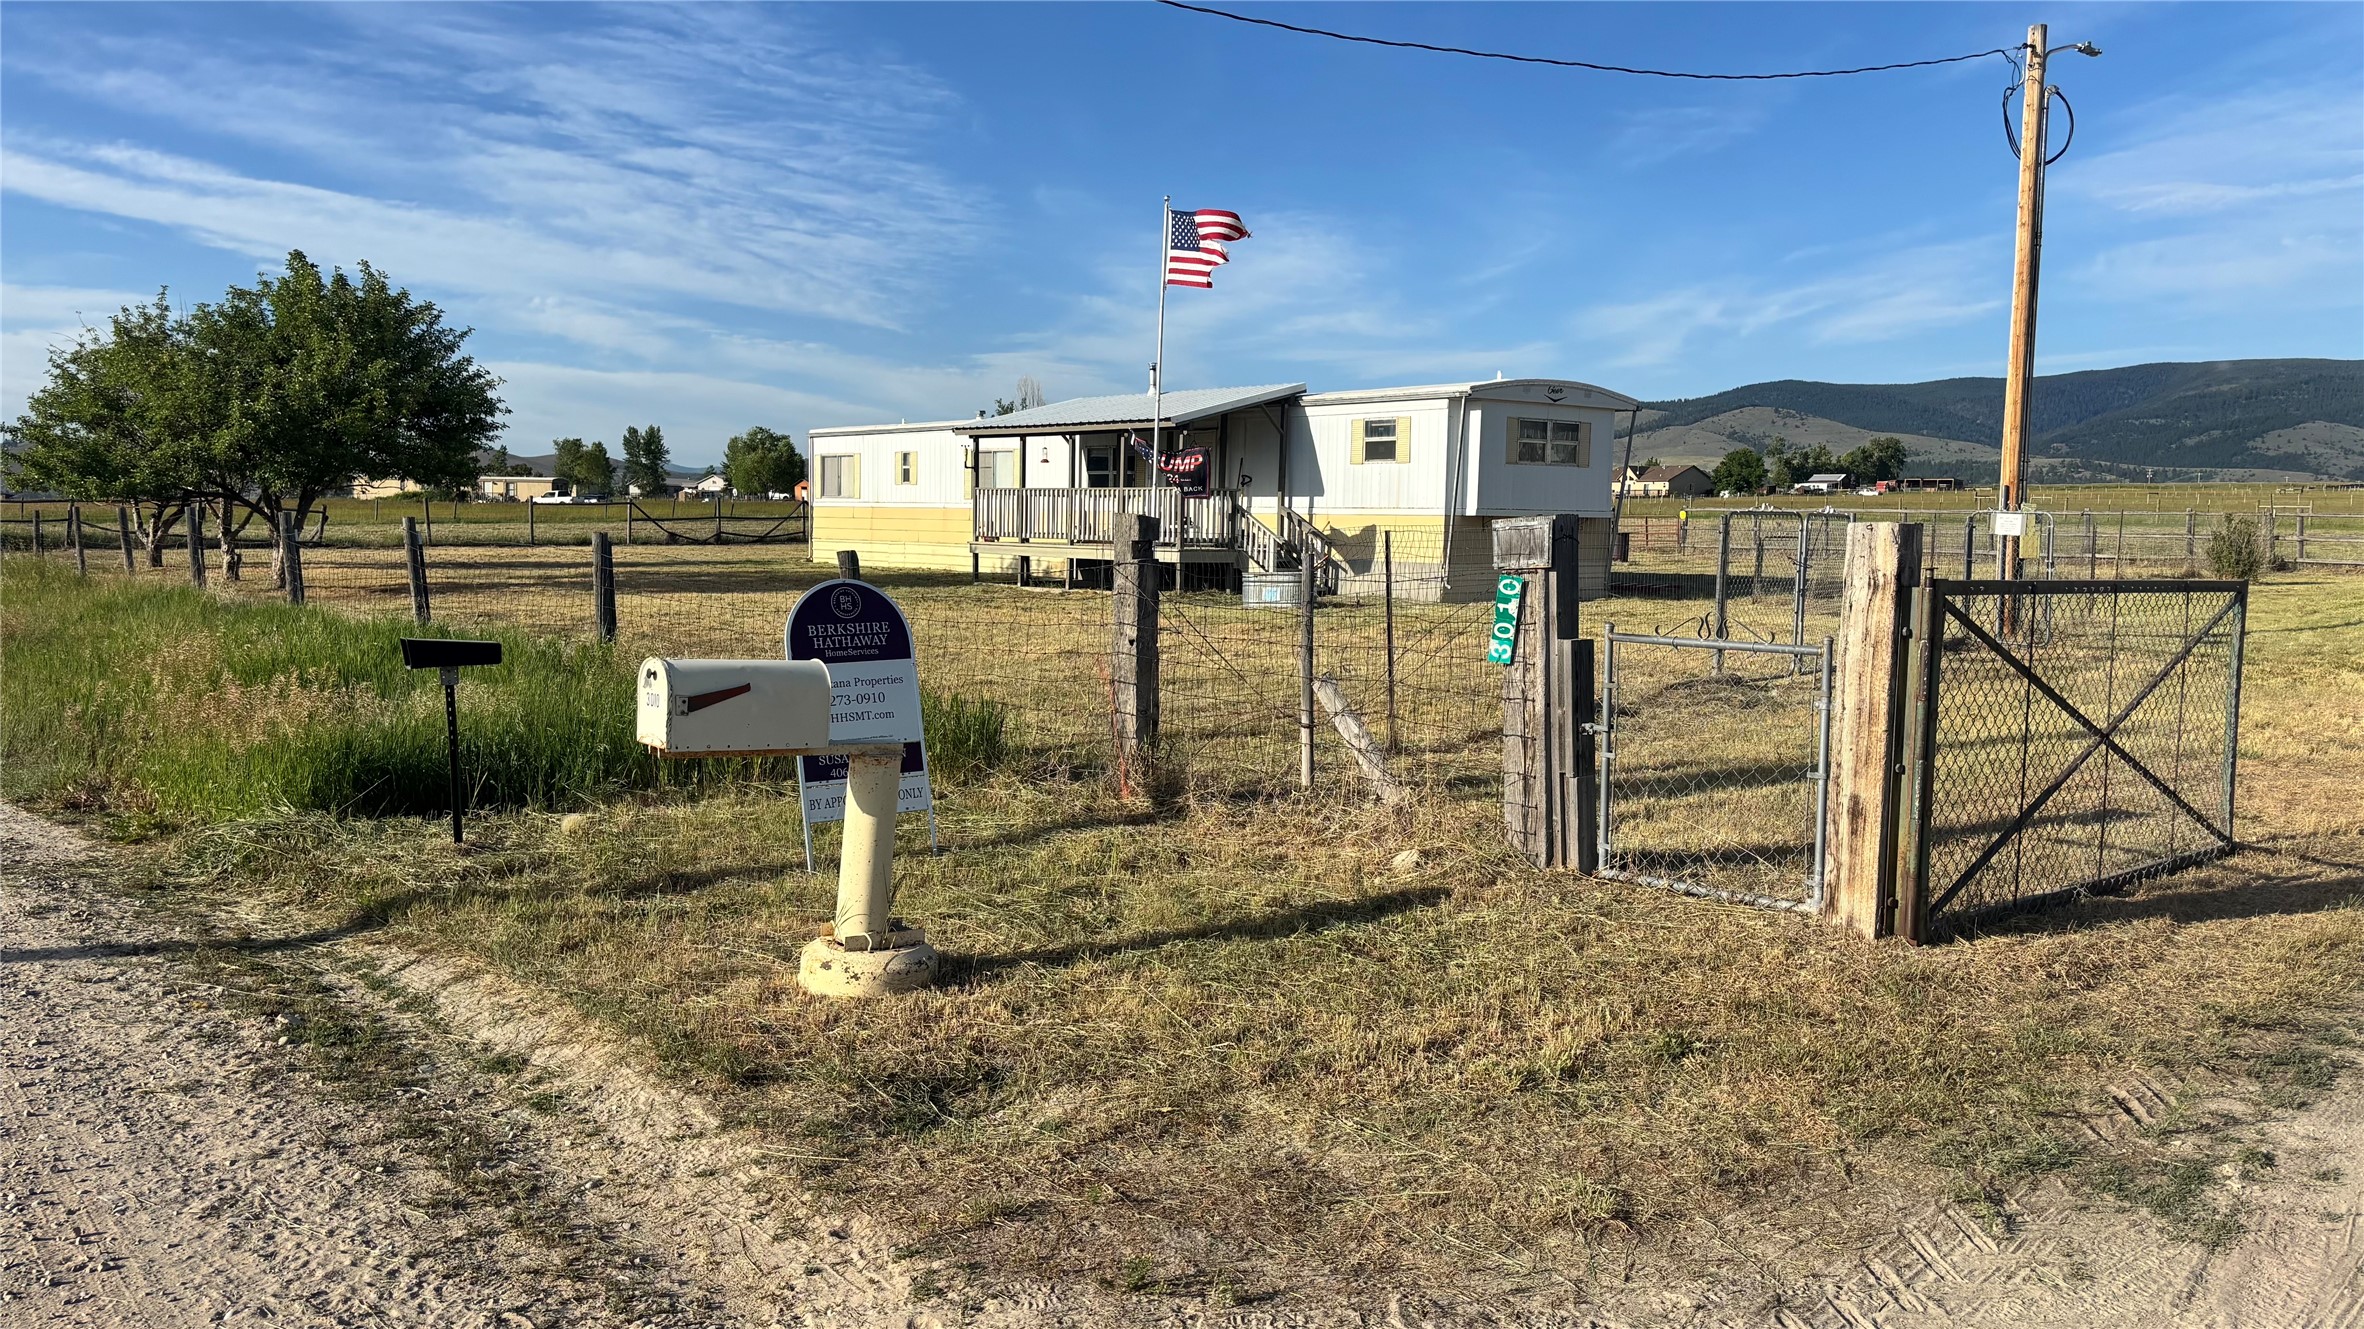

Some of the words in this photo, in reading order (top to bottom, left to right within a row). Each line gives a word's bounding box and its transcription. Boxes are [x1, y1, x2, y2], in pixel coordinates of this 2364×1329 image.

[1160, 454, 1203, 472] UMP
[1490, 579, 1521, 660] 3010
[807, 621, 891, 637] BERKSHIRE
[813, 634, 888, 648] HATHAWAY
[825, 648, 879, 658] HomeServices
[853, 674, 904, 688] Properties
[830, 691, 886, 707] 273-0910
[830, 710, 895, 723] HHSMT.com
[818, 754, 850, 766] SUSA
[809, 798, 822, 811] BY
[898, 786, 924, 801] ONLY
